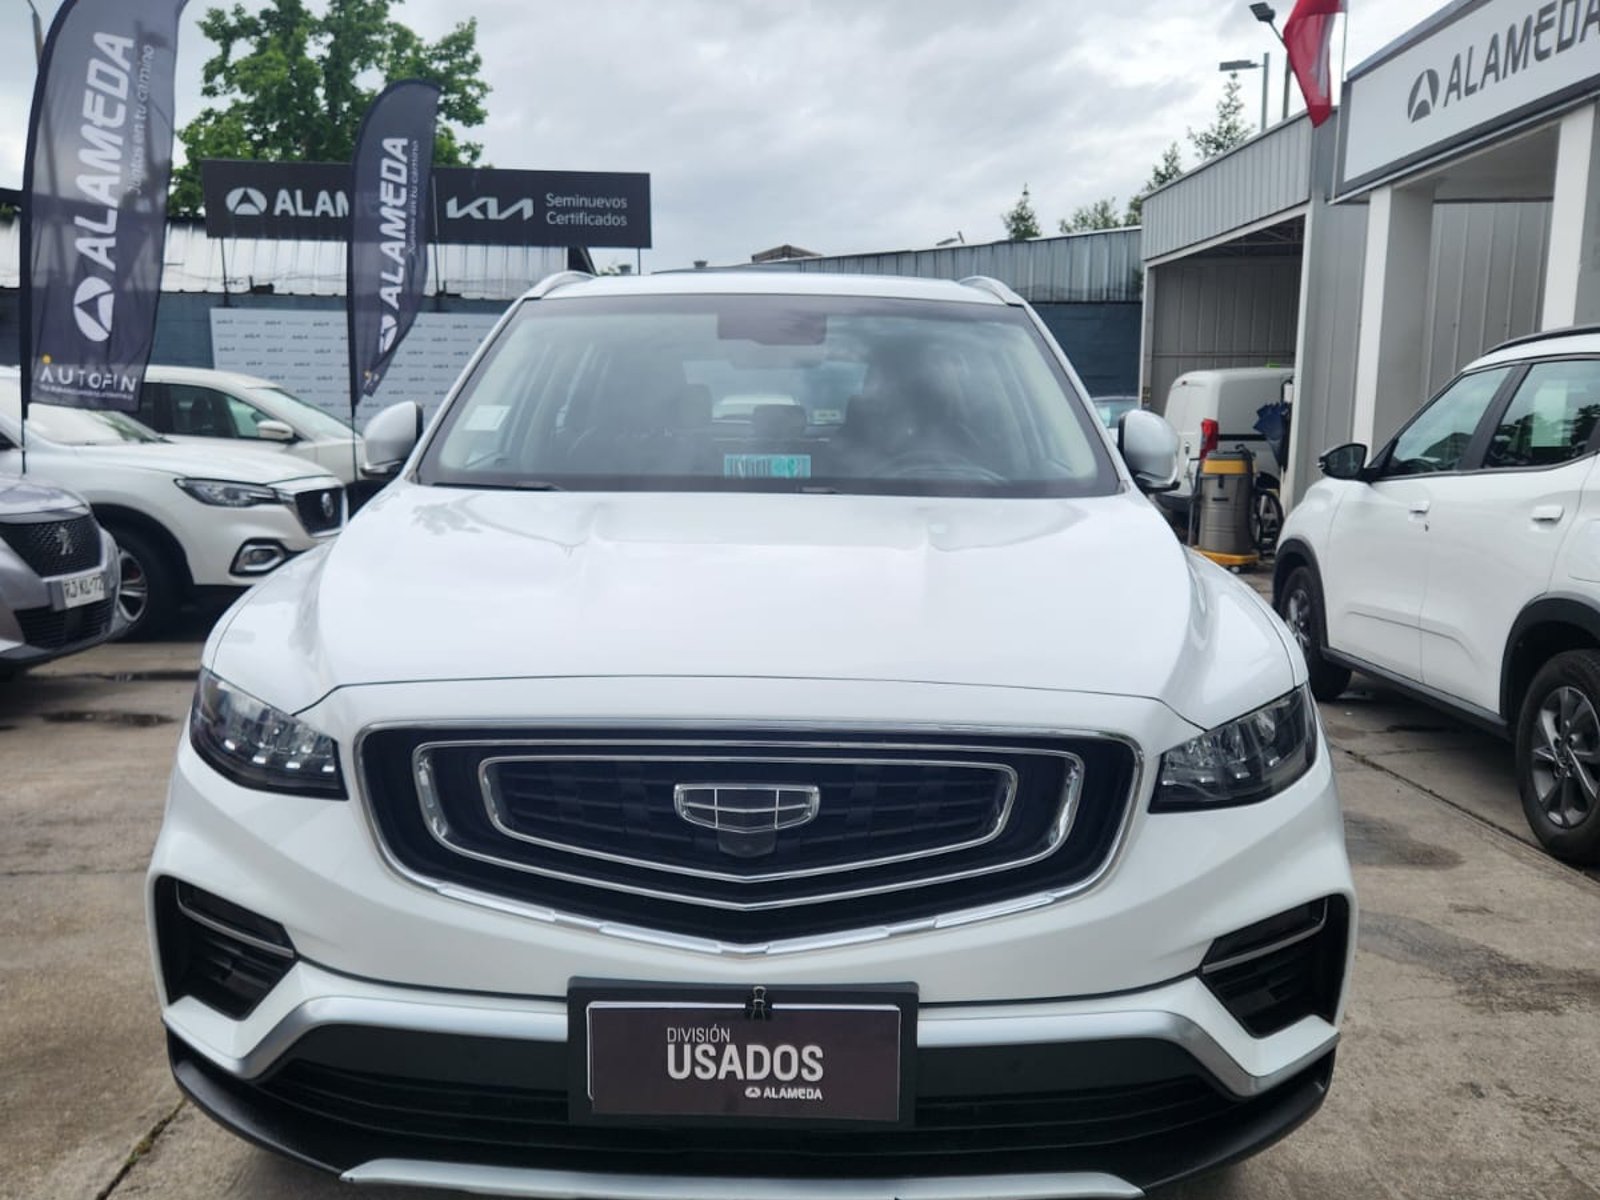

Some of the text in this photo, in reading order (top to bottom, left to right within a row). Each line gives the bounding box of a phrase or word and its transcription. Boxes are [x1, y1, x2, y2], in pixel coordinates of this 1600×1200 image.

[1443, 0, 1600, 107] ALAMEDA
[137, 44, 155, 102] camino
[134, 104, 147, 121] tu
[74, 32, 134, 272] ALAMEDA
[273, 188, 349, 218] ALAM
[446, 196, 534, 221] KIA
[545, 192, 628, 209] Seminuevos
[379, 137, 408, 310] ALAMEDA
[545, 211, 628, 227] Certificados
[40, 365, 137, 393] AUTOFIN
[666, 1023, 731, 1043] DIVISIÓN
[666, 1043, 824, 1082] USADOS
[763, 1086, 823, 1100] ALAMEDA
